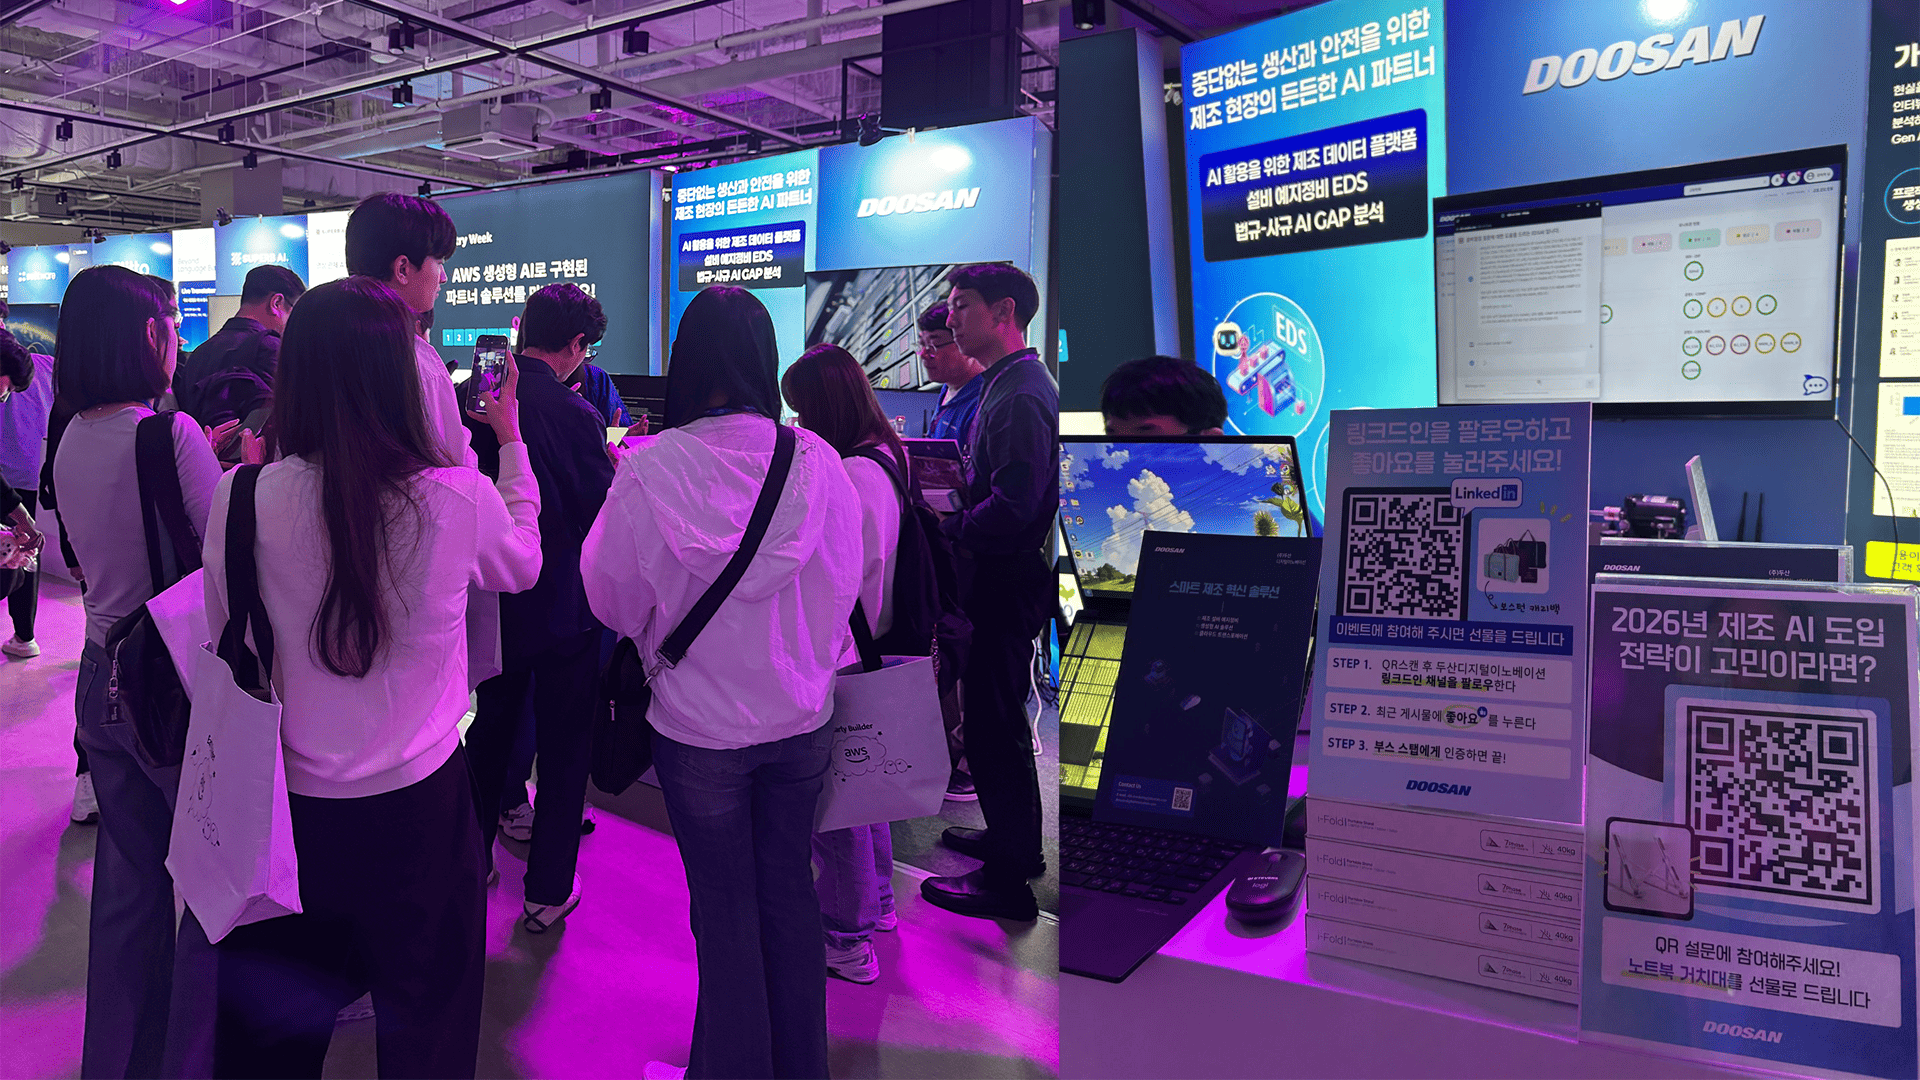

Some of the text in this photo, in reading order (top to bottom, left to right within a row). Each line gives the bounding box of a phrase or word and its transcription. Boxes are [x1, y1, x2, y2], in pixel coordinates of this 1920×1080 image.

[1191, 7, 1430, 98] 중단없는 생산과 안전을 위한
[1522, 14, 1766, 96] DOOSAN
[1190, 45, 1435, 130] 제조 현장의 든든한 AI 파트너
[1891, 133, 1916, 145] Gen
[1206, 127, 1417, 187] AI 활용을 위한 제조 데이터 플랫폼
[677, 168, 811, 204] 중단없는 생산과 안전을 위한
[1246, 171, 1368, 211] 설비 예지정비 EDS
[674, 188, 812, 221] 제조 현장의 든든한 AI 파트너
[857, 187, 981, 218] DOOSAN
[1294, 212, 1312, 233] AI
[1314, 207, 1351, 231] GAP
[1353, 201, 1384, 227] 분석
[468, 231, 493, 245] Week
[682, 241, 692, 252] AI
[692, 238, 714, 252] 활용을
[715, 236, 731, 249] 위한
[731, 235, 748, 248] 제조
[748, 232, 774, 246] 데이터
[242, 253, 276, 263] SUPERB
[704, 254, 720, 267] 설비
[752, 250, 774, 263] EDS
[451, 258, 588, 284] AWS 생성형 AI로 구현된
[731, 269, 741, 281] AI
[741, 267, 763, 280] GAP
[445, 287, 478, 306] 파트너
[1276, 311, 1307, 355] EDS
[1346, 417, 1572, 446] 링크드인을 팔로우하고
[1352, 449, 1562, 475] 좋아요를 눌러주세요!
[1155, 546, 1185, 554] DOOSAN
[1603, 564, 1641, 572] DOOSAN
[1768, 569, 1791, 577] (주)두산
[1168, 580, 1280, 599] 스마트 제조 혁신 솔루션
[1500, 603, 1526, 613] 보스턴
[1337, 622, 1565, 648] 이벤트에 참여해 주시면 선물을 드립니다
[1611, 606, 1885, 648] 2026년 제조 AI 도입
[1333, 657, 1546, 680] STEP 1. QR스캔 후 두산디지털이노베이션
[1619, 641, 1877, 684] 전략이 고민이라면?
[1381, 672, 1516, 693] 링크드인 채널을 팔로우한다
[848, 723, 873, 732] Builder
[1330, 702, 1537, 731] STEP 2. 최근 게시물에 좋아요 를 누른다
[844, 746, 868, 757] aws
[1327, 737, 1507, 764] STEP 3. 부스 스탭에게 인증하면 끝!
[1118, 781, 1135, 789] Contact
[1406, 779, 1471, 796] DOOSAN
[1557, 846, 1576, 856] 40kg
[1554, 891, 1572, 902] 40kg
[1554, 932, 1574, 943] 40kg
[1655, 936, 1841, 978] QR 설문에 참여해주세요!
[1554, 974, 1573, 986] 40kg
[1628, 957, 1871, 1009] 노트북 거치대를 선물로 드립니다
[1702, 1020, 1784, 1044] DOOSAN
